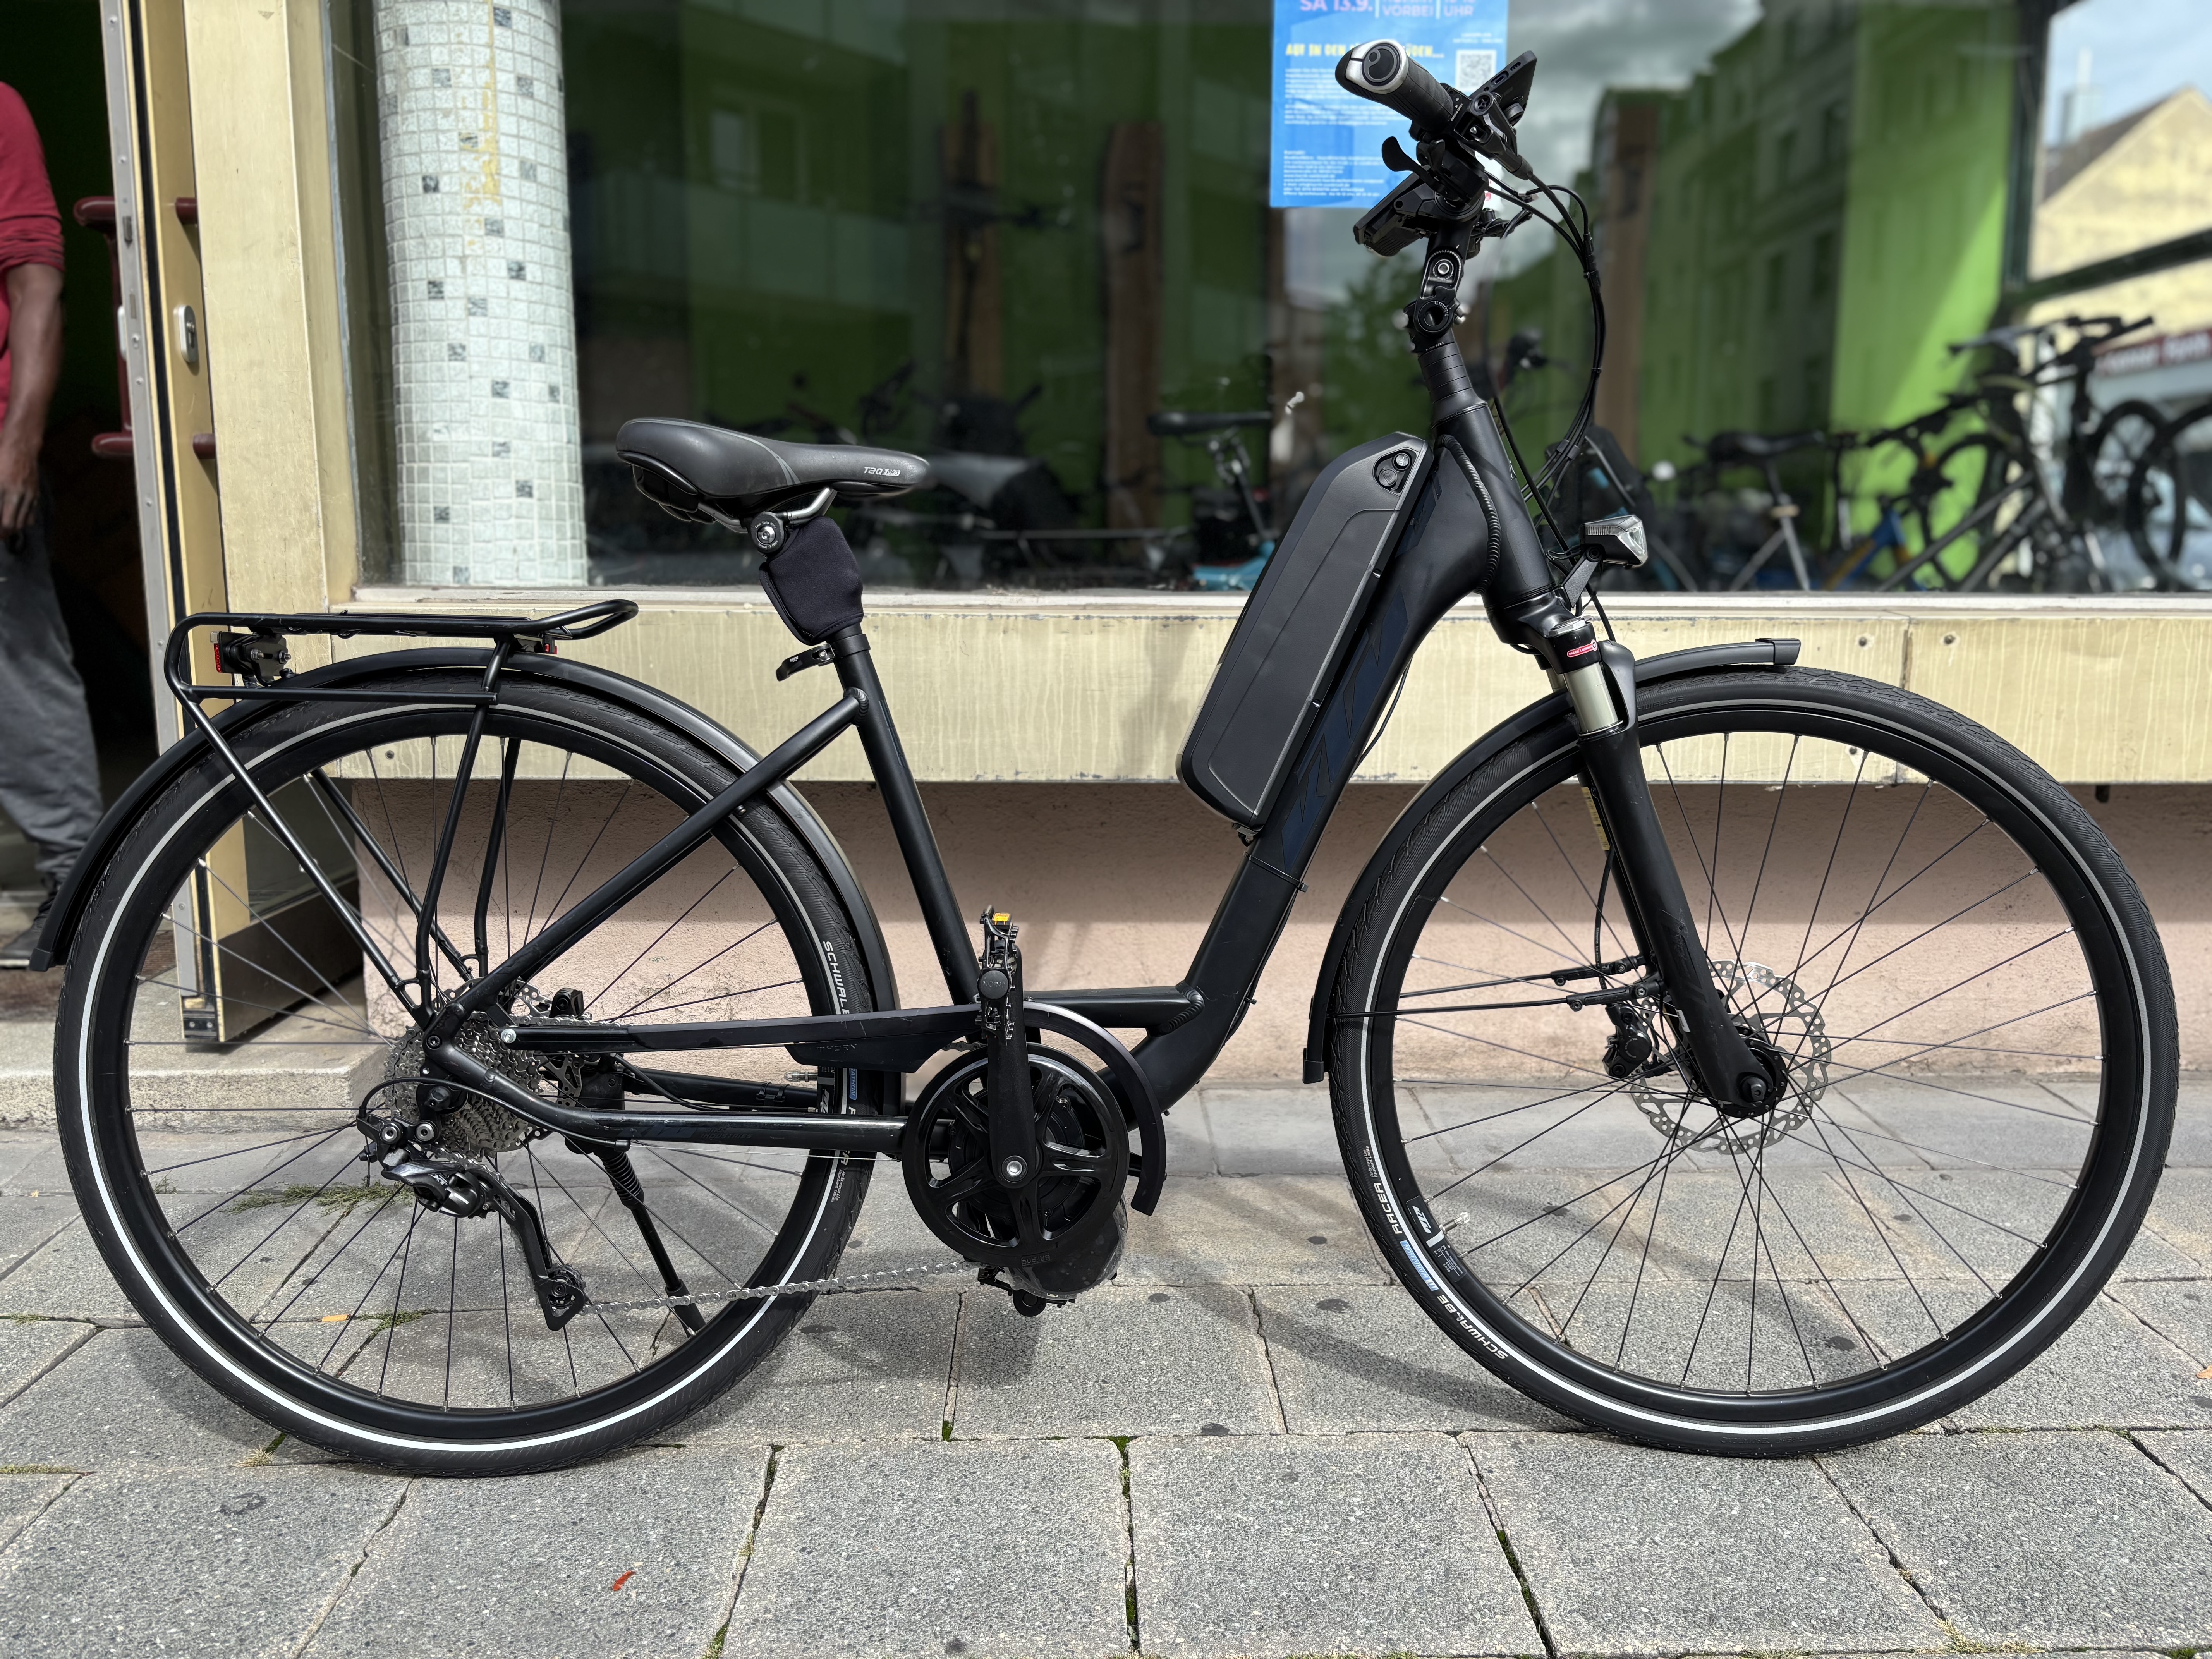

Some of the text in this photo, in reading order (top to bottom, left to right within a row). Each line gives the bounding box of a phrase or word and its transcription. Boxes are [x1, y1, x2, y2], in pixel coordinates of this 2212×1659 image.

[1382, 5, 1433, 17] VORBEI
[1444, 5, 1474, 17] UHR
[1374, 1182, 1403, 1235] RACER
[1021, 1254, 1050, 1264] BAFANG
[1403, 1243, 1429, 1279] MARATHON
[1437, 1295, 1508, 1360] SCHWALBE
